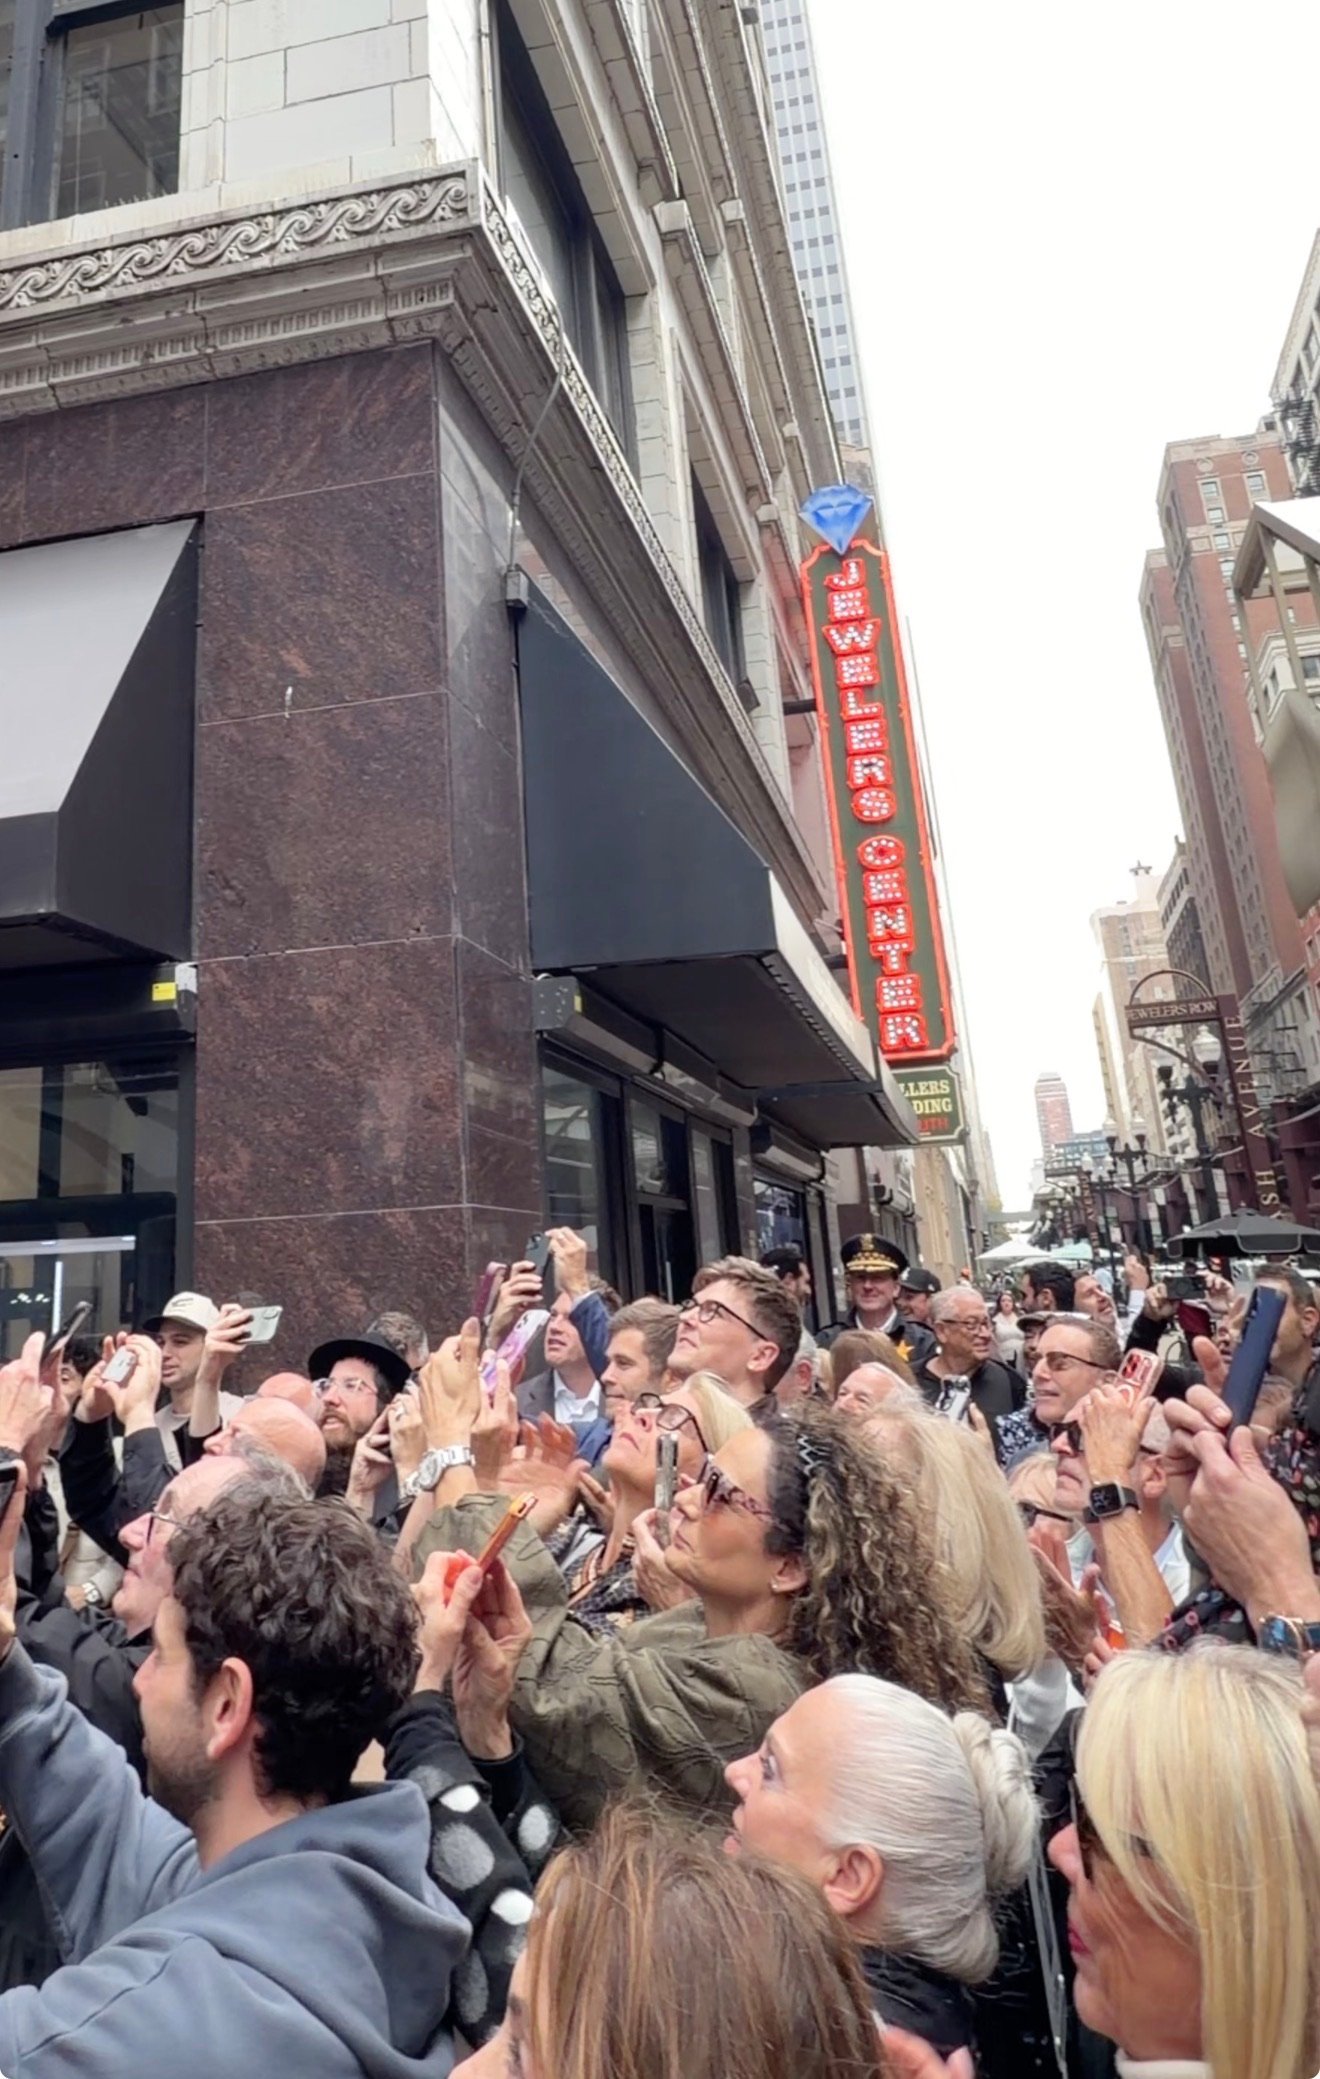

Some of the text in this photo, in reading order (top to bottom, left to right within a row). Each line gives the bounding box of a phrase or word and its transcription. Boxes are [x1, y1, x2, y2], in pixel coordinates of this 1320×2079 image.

[822, 559, 928, 1051] JEWELERS CENTER
[1188, 1000, 1217, 1015] ROW
[1225, 1015, 1266, 1138] AVENUE
